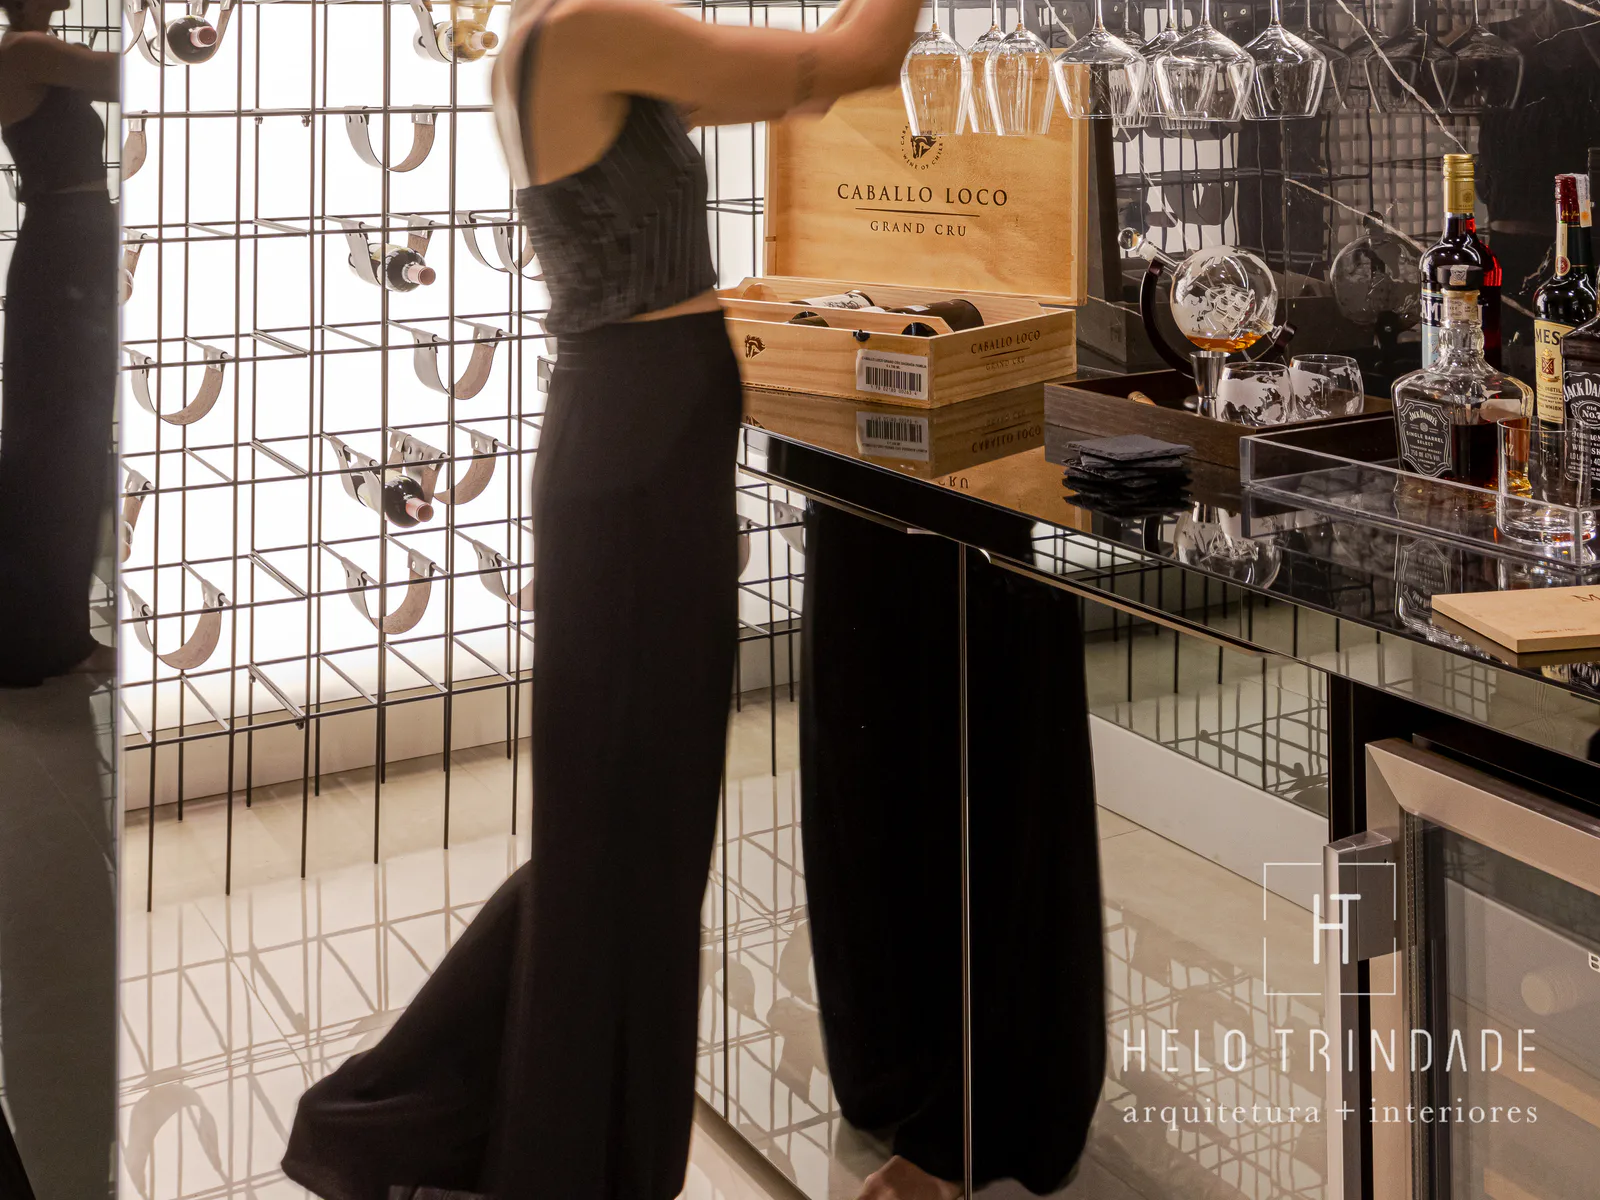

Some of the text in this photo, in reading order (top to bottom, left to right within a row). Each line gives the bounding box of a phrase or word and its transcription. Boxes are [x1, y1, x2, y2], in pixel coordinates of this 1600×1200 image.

[837, 183, 1008, 207] CABALLO LOCO
[870, 220, 967, 237] GRAND CRU
[971, 330, 1041, 354] CABALLO LOCO
[1563, 382, 1585, 402] JACK
[1408, 410, 1419, 421] JACK
[1405, 430, 1444, 444] SINGLE BARREL
[1416, 439, 1434, 447] SELECT
